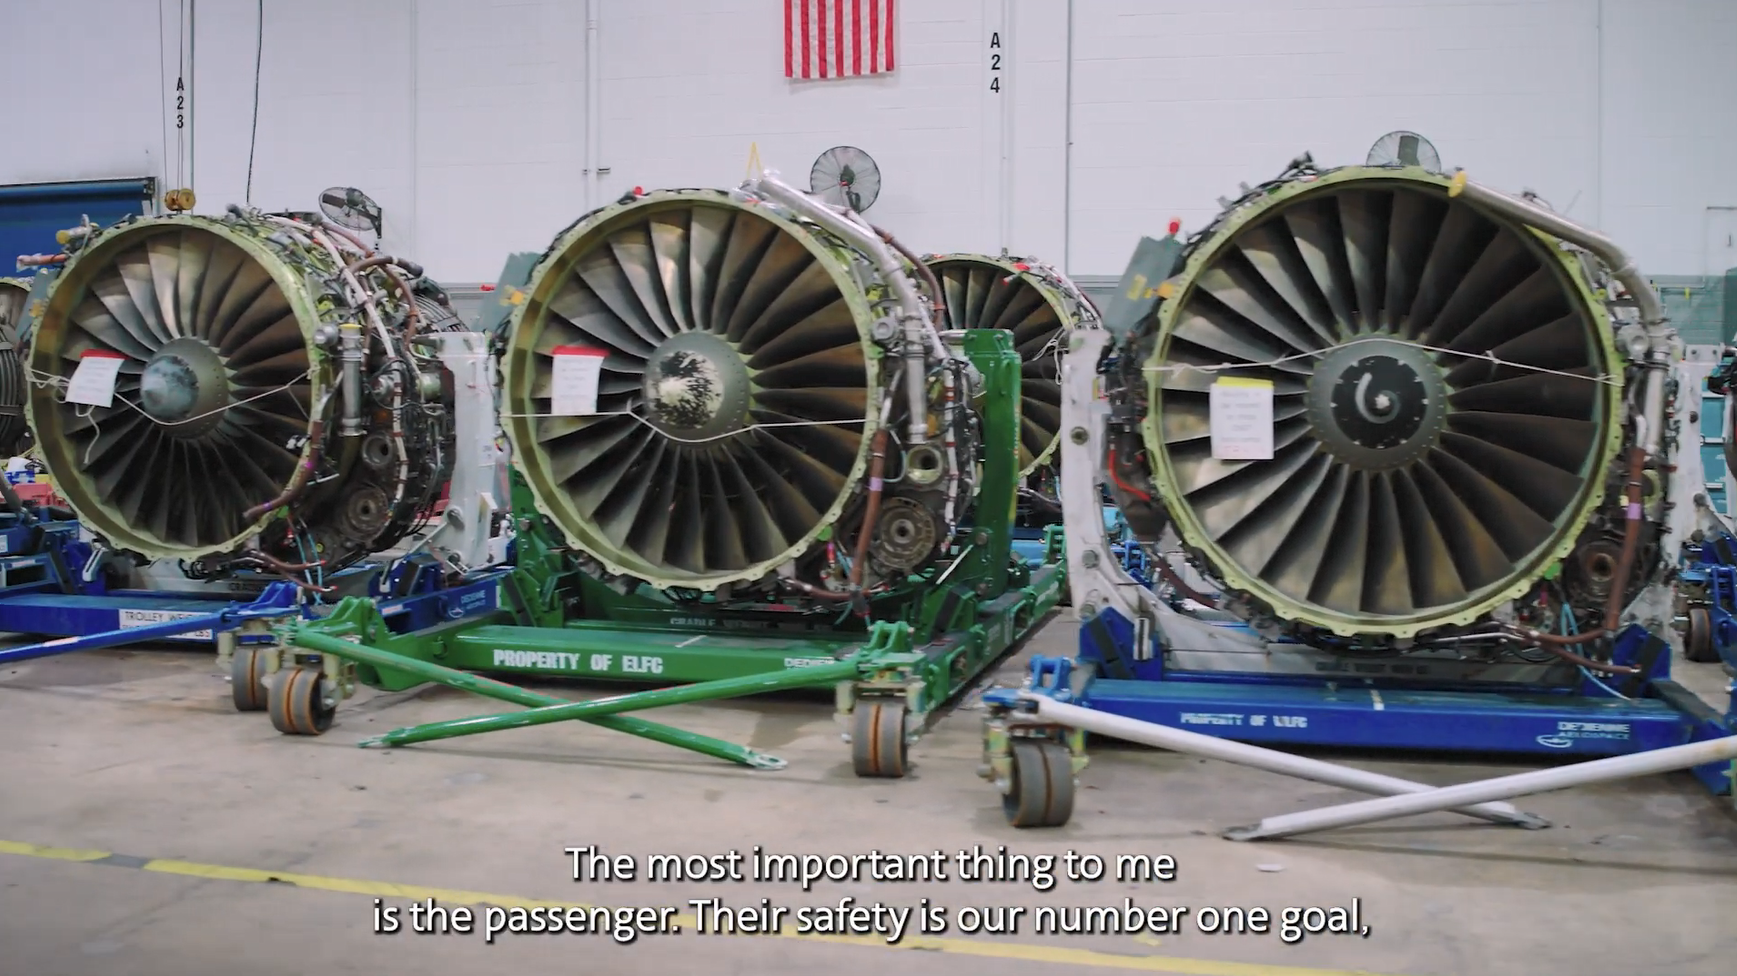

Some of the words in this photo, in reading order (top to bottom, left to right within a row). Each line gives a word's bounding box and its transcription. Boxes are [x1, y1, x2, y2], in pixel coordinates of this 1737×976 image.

[990, 32, 1001, 93] A24
[176, 76, 184, 129] A23
[493, 649, 580, 670] PROPERTY
[590, 653, 613, 671] OF
[622, 655, 664, 674] ELFC
